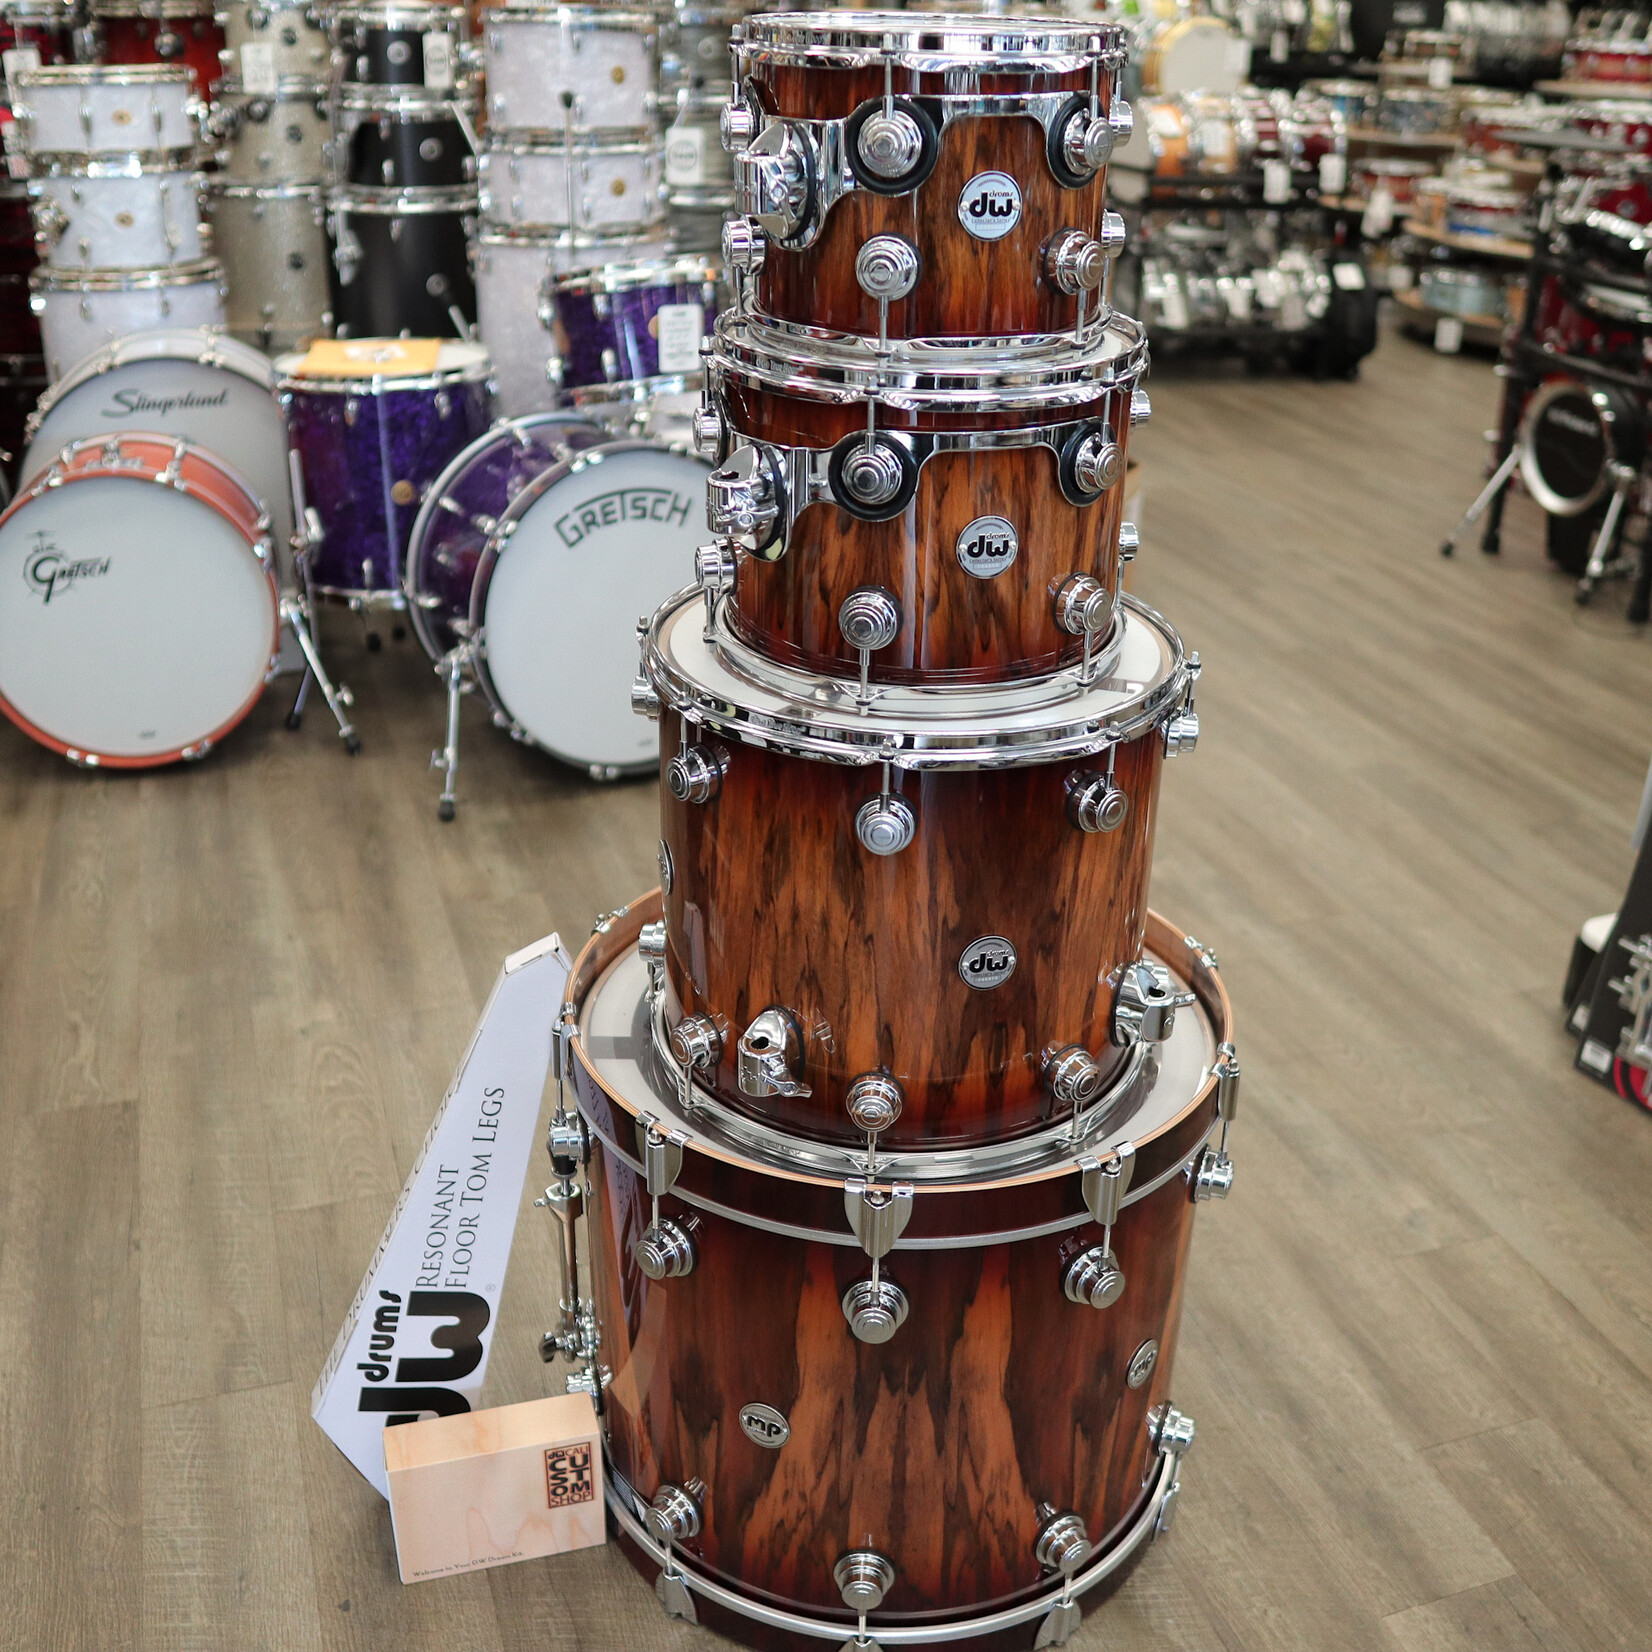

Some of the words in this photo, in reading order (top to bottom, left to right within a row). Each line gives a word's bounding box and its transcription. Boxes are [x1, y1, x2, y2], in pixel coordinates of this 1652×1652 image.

[969, 192, 1013, 217] dw
[101, 388, 228, 418] Slingerland
[554, 488, 692, 547] GRETSCH
[967, 535, 1009, 558] dw
[969, 953, 1009, 973] dw
[472, 1086, 505, 1144] LEGS
[459, 1152, 493, 1203] TOM
[415, 1164, 460, 1289] RESONANT
[444, 1212, 481, 1289] FLOOR
[356, 1289, 402, 1383] drums
[550, 1491, 591, 1505] SHOP
